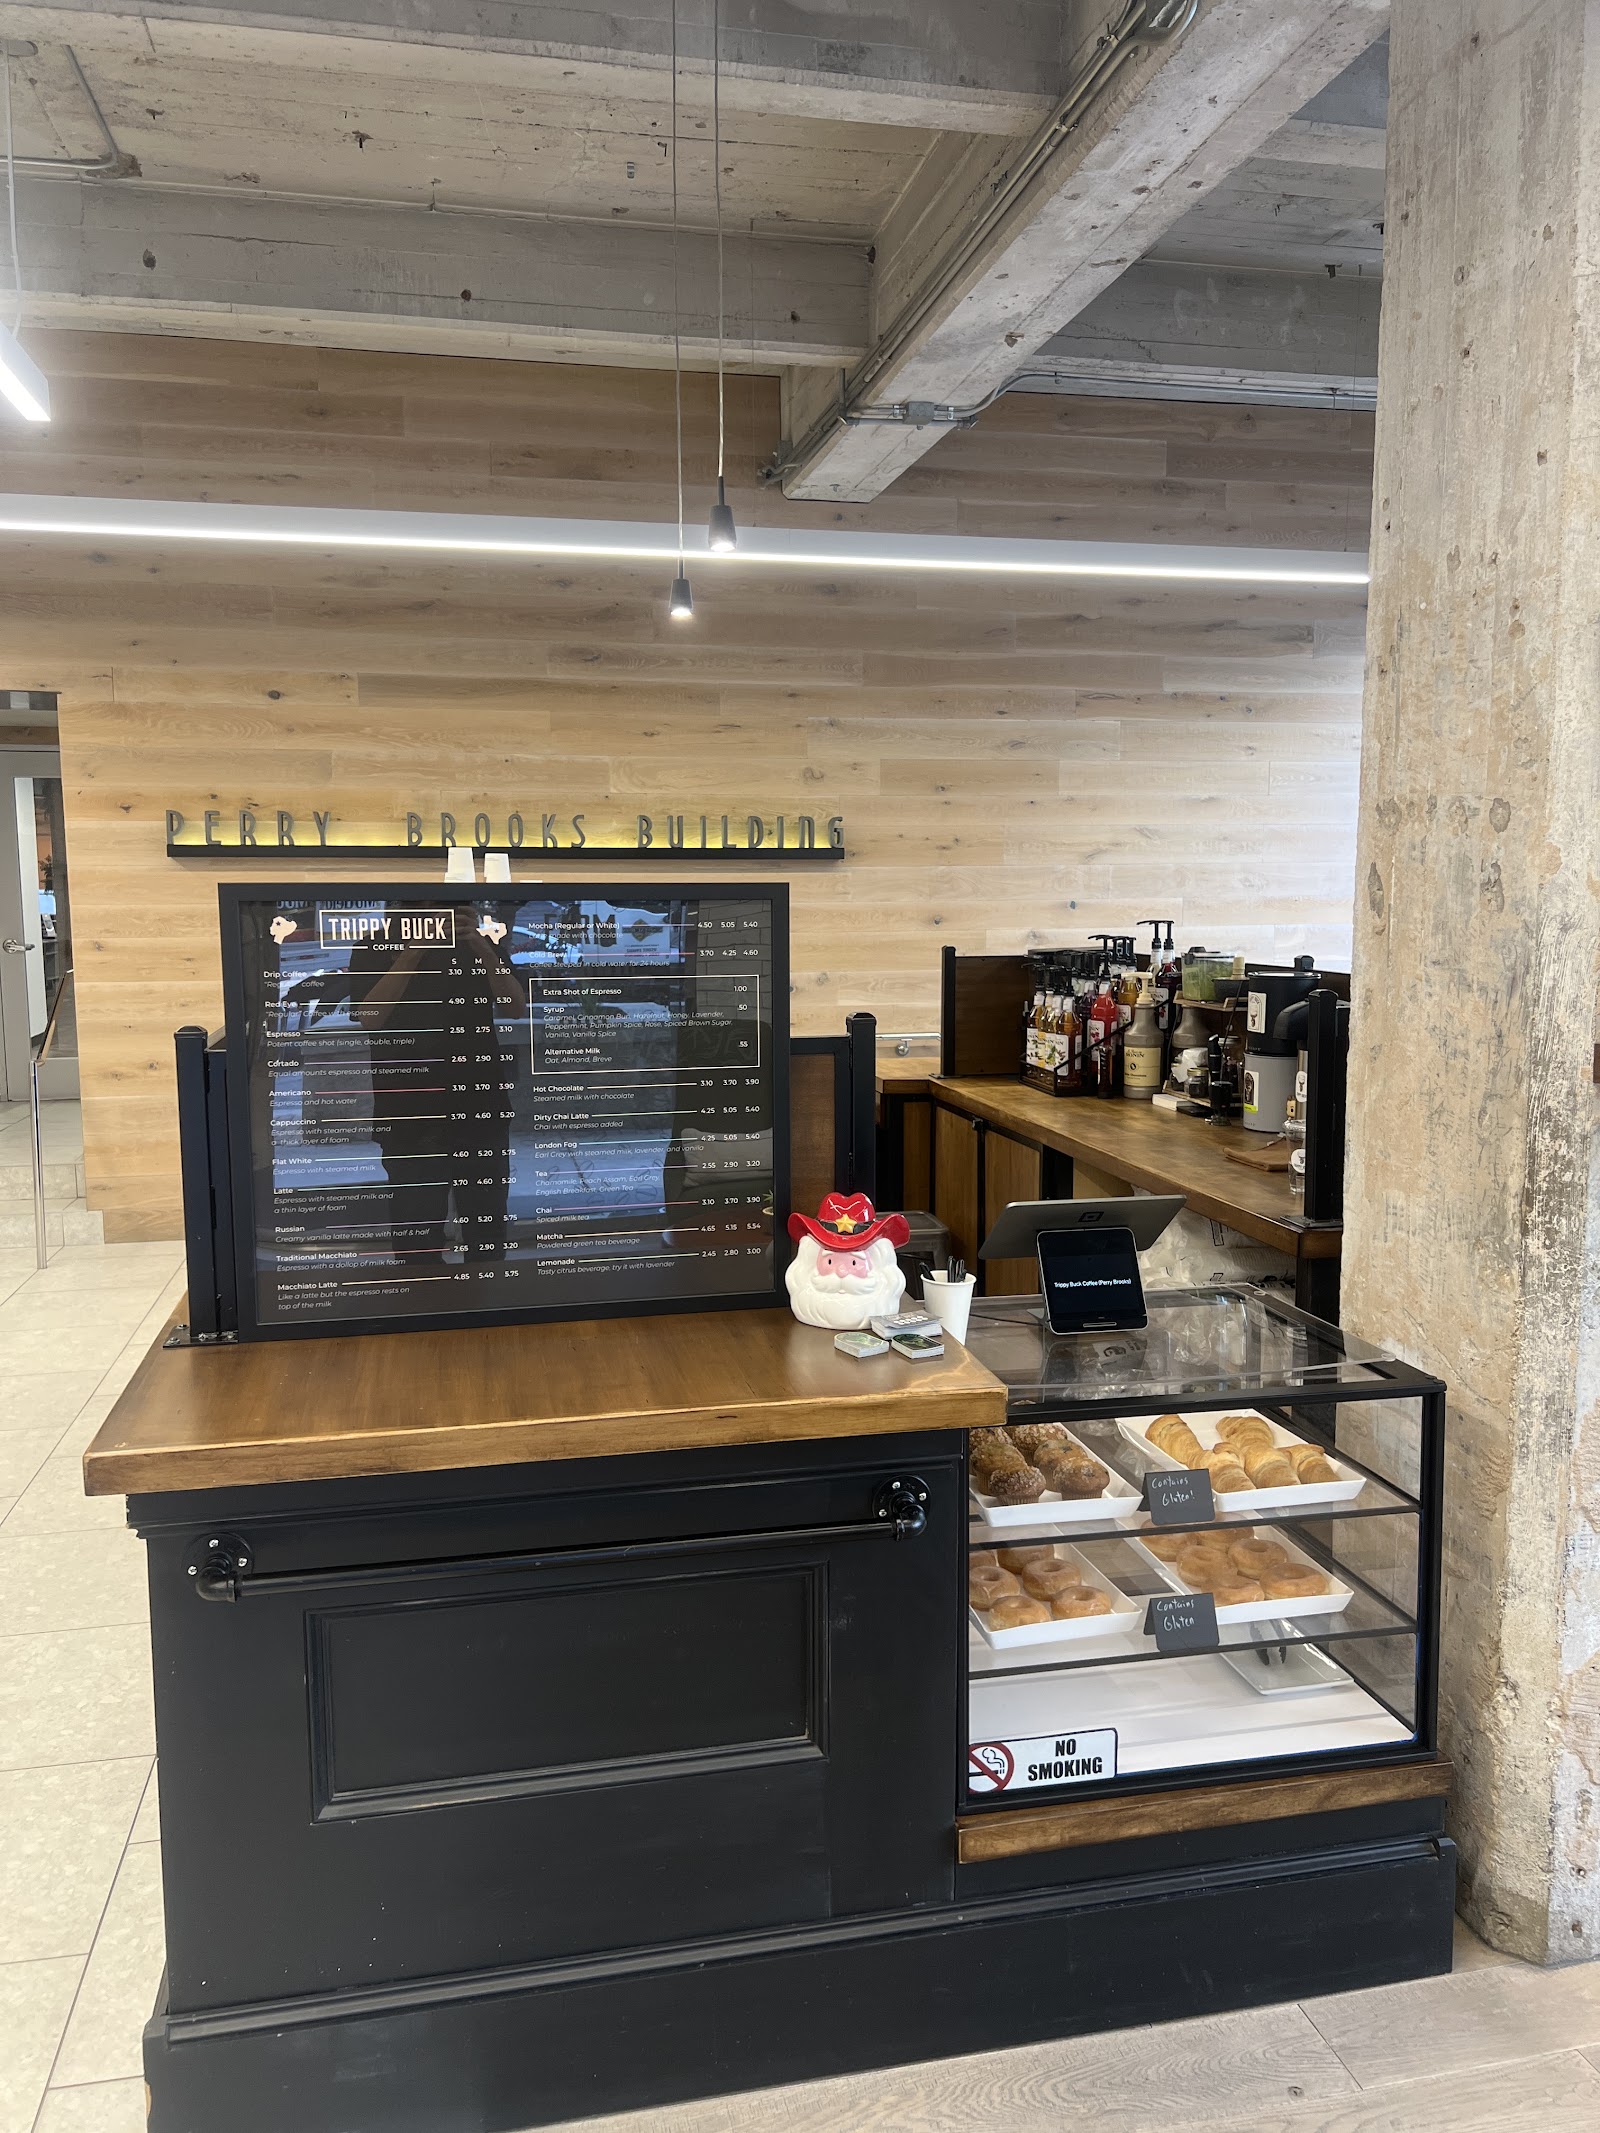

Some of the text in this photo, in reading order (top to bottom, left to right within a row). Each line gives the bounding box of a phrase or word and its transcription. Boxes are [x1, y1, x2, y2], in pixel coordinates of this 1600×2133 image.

[167, 810, 844, 849] PERRY BROOKS BUILDING
[328, 918, 446, 940] TRIPPY BUCK
[596, 922, 620, 930] White)
[264, 971, 280, 979] Drip
[590, 988, 622, 996] Espresso
[544, 1006, 564, 1014] Syrup
[293, 1039, 316, 1047] coffee
[393, 1038, 415, 1046] triple)
[534, 1114, 551, 1122] Dirty
[270, 1119, 316, 1127] Cappuccino
[564, 1141, 577, 1149] Fog
[536, 1241, 572, 1249] Powdered
[573, 1240, 593, 1248] green
[608, 1237, 640, 1246] beverage
[276, 1251, 357, 1262] Traditional Macchiato
[537, 1258, 575, 1266] Lemonade
[277, 1282, 317, 1290] Macchiato
[1152, 1475, 1189, 1489] Contains
[1156, 1600, 1195, 1612] Contains
[1163, 1615, 1195, 1631] Gluten
[1055, 1739, 1077, 1757] NO
[1027, 1757, 1103, 1782] SMOKING
